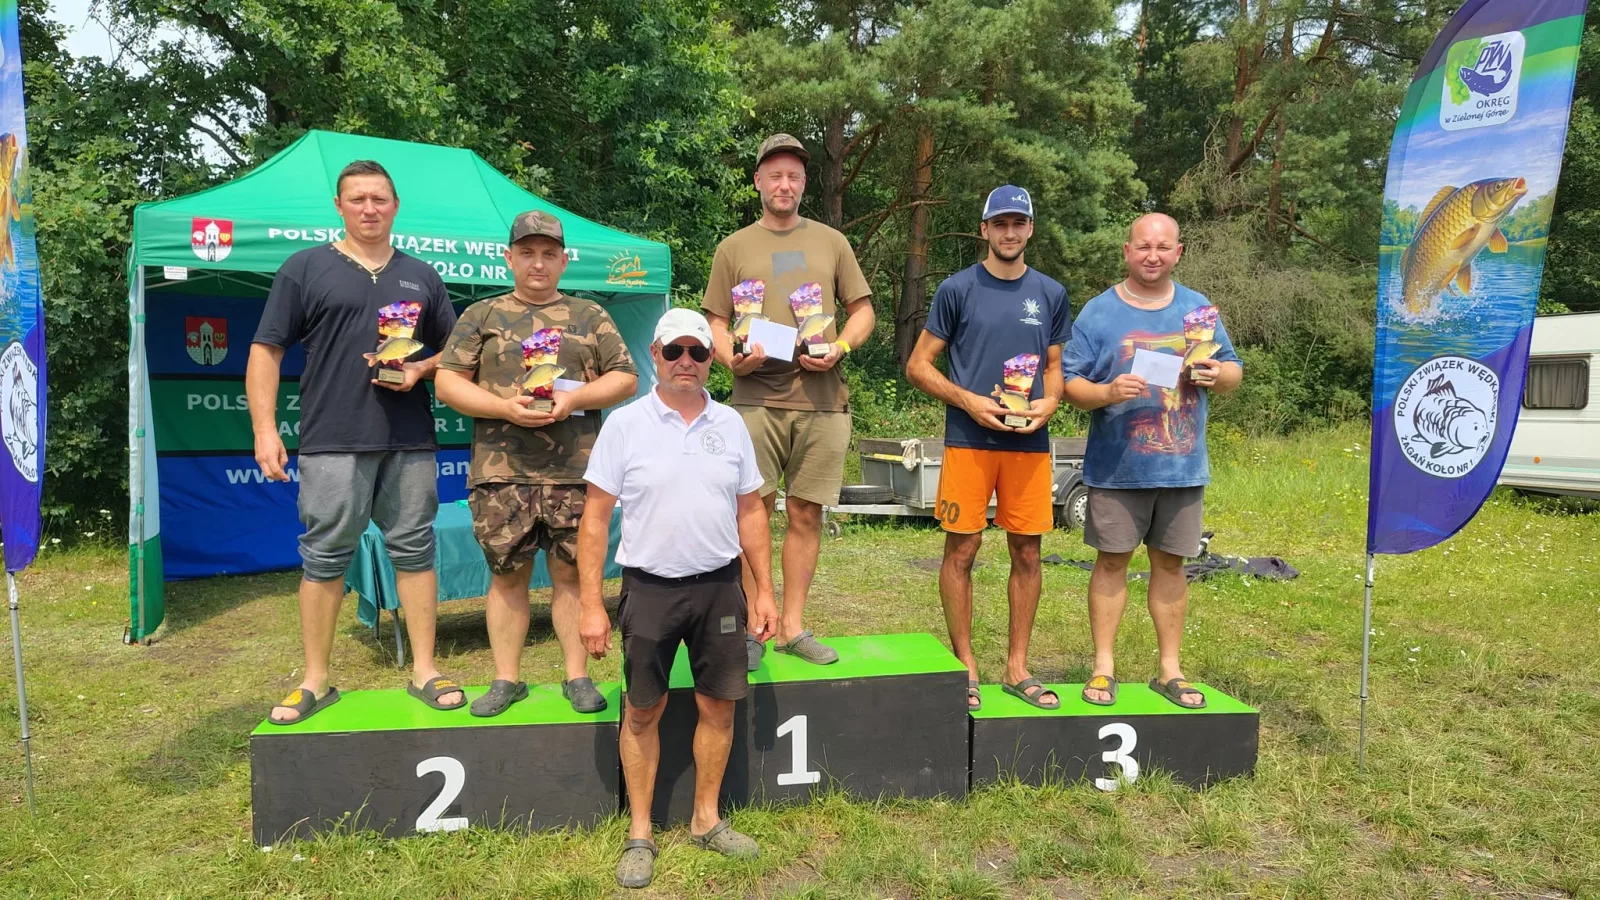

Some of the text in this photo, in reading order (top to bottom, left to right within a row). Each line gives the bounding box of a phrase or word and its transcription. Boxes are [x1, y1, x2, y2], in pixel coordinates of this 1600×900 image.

[1474, 40, 1511, 73] PZW
[1452, 110, 1484, 123] Zielonej
[1485, 108, 1510, 119] Górze
[1476, 96, 1510, 109] OKRĘG
[268, 227, 347, 242] POLSK
[427, 260, 508, 280] OŁO NR
[1397, 378, 1419, 417] POLSKI
[1416, 360, 1465, 381] ZWIĄZEK
[455, 417, 466, 432] 1
[1400, 434, 1426, 466] ŻAGAŃ
[1425, 461, 1455, 475] KOŁO
[1456, 463, 1469, 474] NR
[940, 499, 960, 525] 20
[777, 715, 821, 786] 1
[1095, 722, 1139, 791] 3
[415, 756, 469, 833] 2
